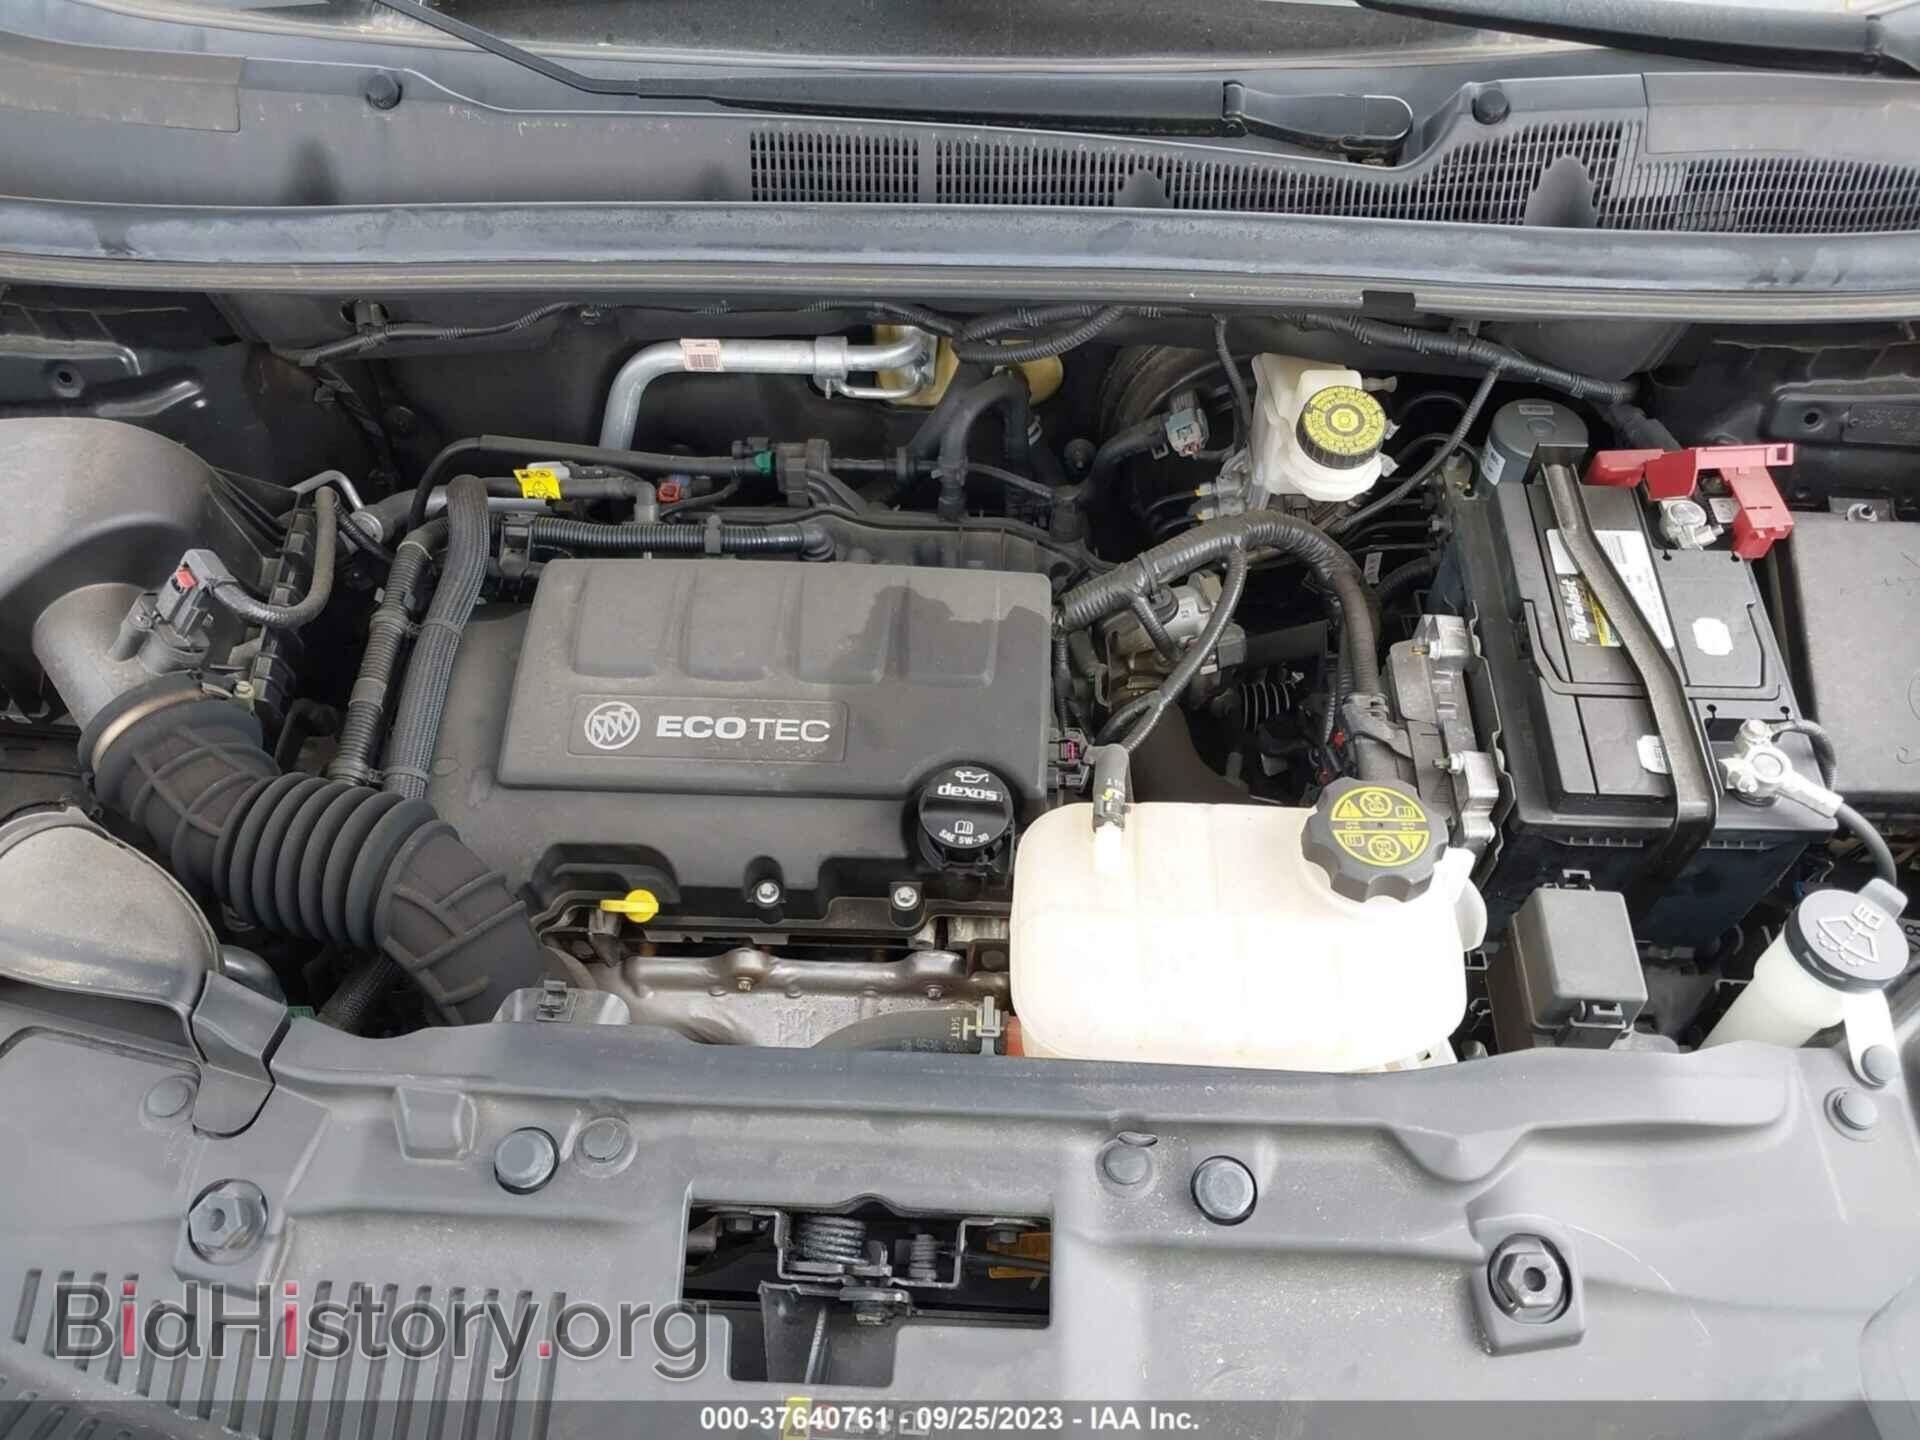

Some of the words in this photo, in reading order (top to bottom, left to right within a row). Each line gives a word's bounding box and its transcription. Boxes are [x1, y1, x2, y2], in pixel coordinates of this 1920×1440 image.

[656, 715, 831, 742] ECOTEC
[937, 783, 998, 801] dexos
[939, 829, 955, 842] SAE
[958, 833, 989, 845] 5W-30
